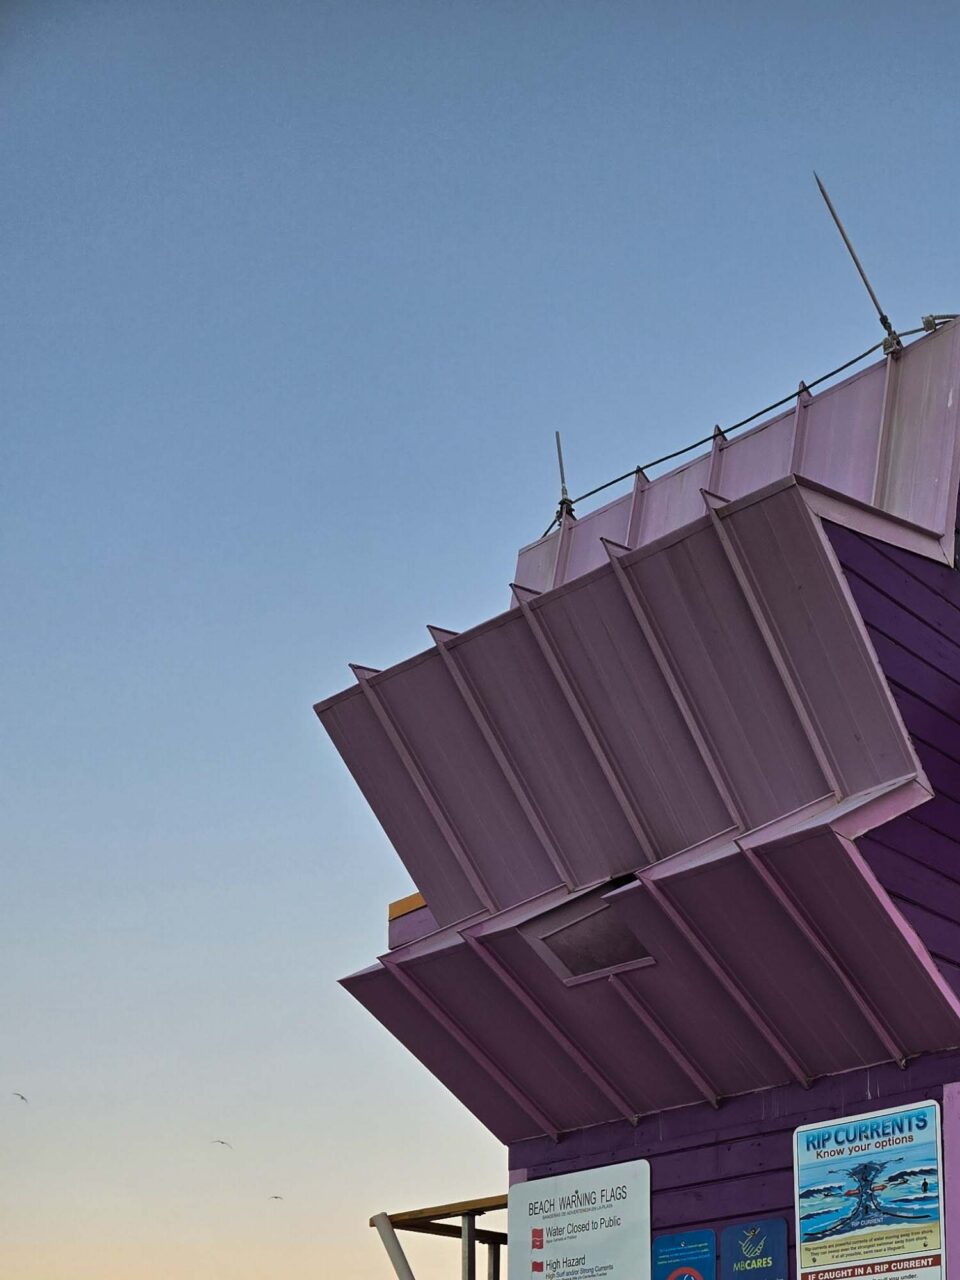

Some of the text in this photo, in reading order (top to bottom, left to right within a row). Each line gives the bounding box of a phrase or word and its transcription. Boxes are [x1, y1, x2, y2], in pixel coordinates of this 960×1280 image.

[806, 1111, 928, 1151] RIP CURRENTS
[816, 1135, 914, 1160] Know your options
[528, 1185, 628, 1216] BEACH WARNING FLAGS
[546, 1216, 621, 1238] Water Closed to Public
[861, 1218, 884, 1226] CURRENT
[546, 1254, 586, 1272] High Hazard
[733, 1257, 772, 1272] MBCARES
[818, 1269, 853, 1280] CAUGHT
[855, 1267, 864, 1275] IN
[866, 1266, 873, 1274] A
[874, 1264, 889, 1273] RIP
[891, 1258, 933, 1270] CURRENT
